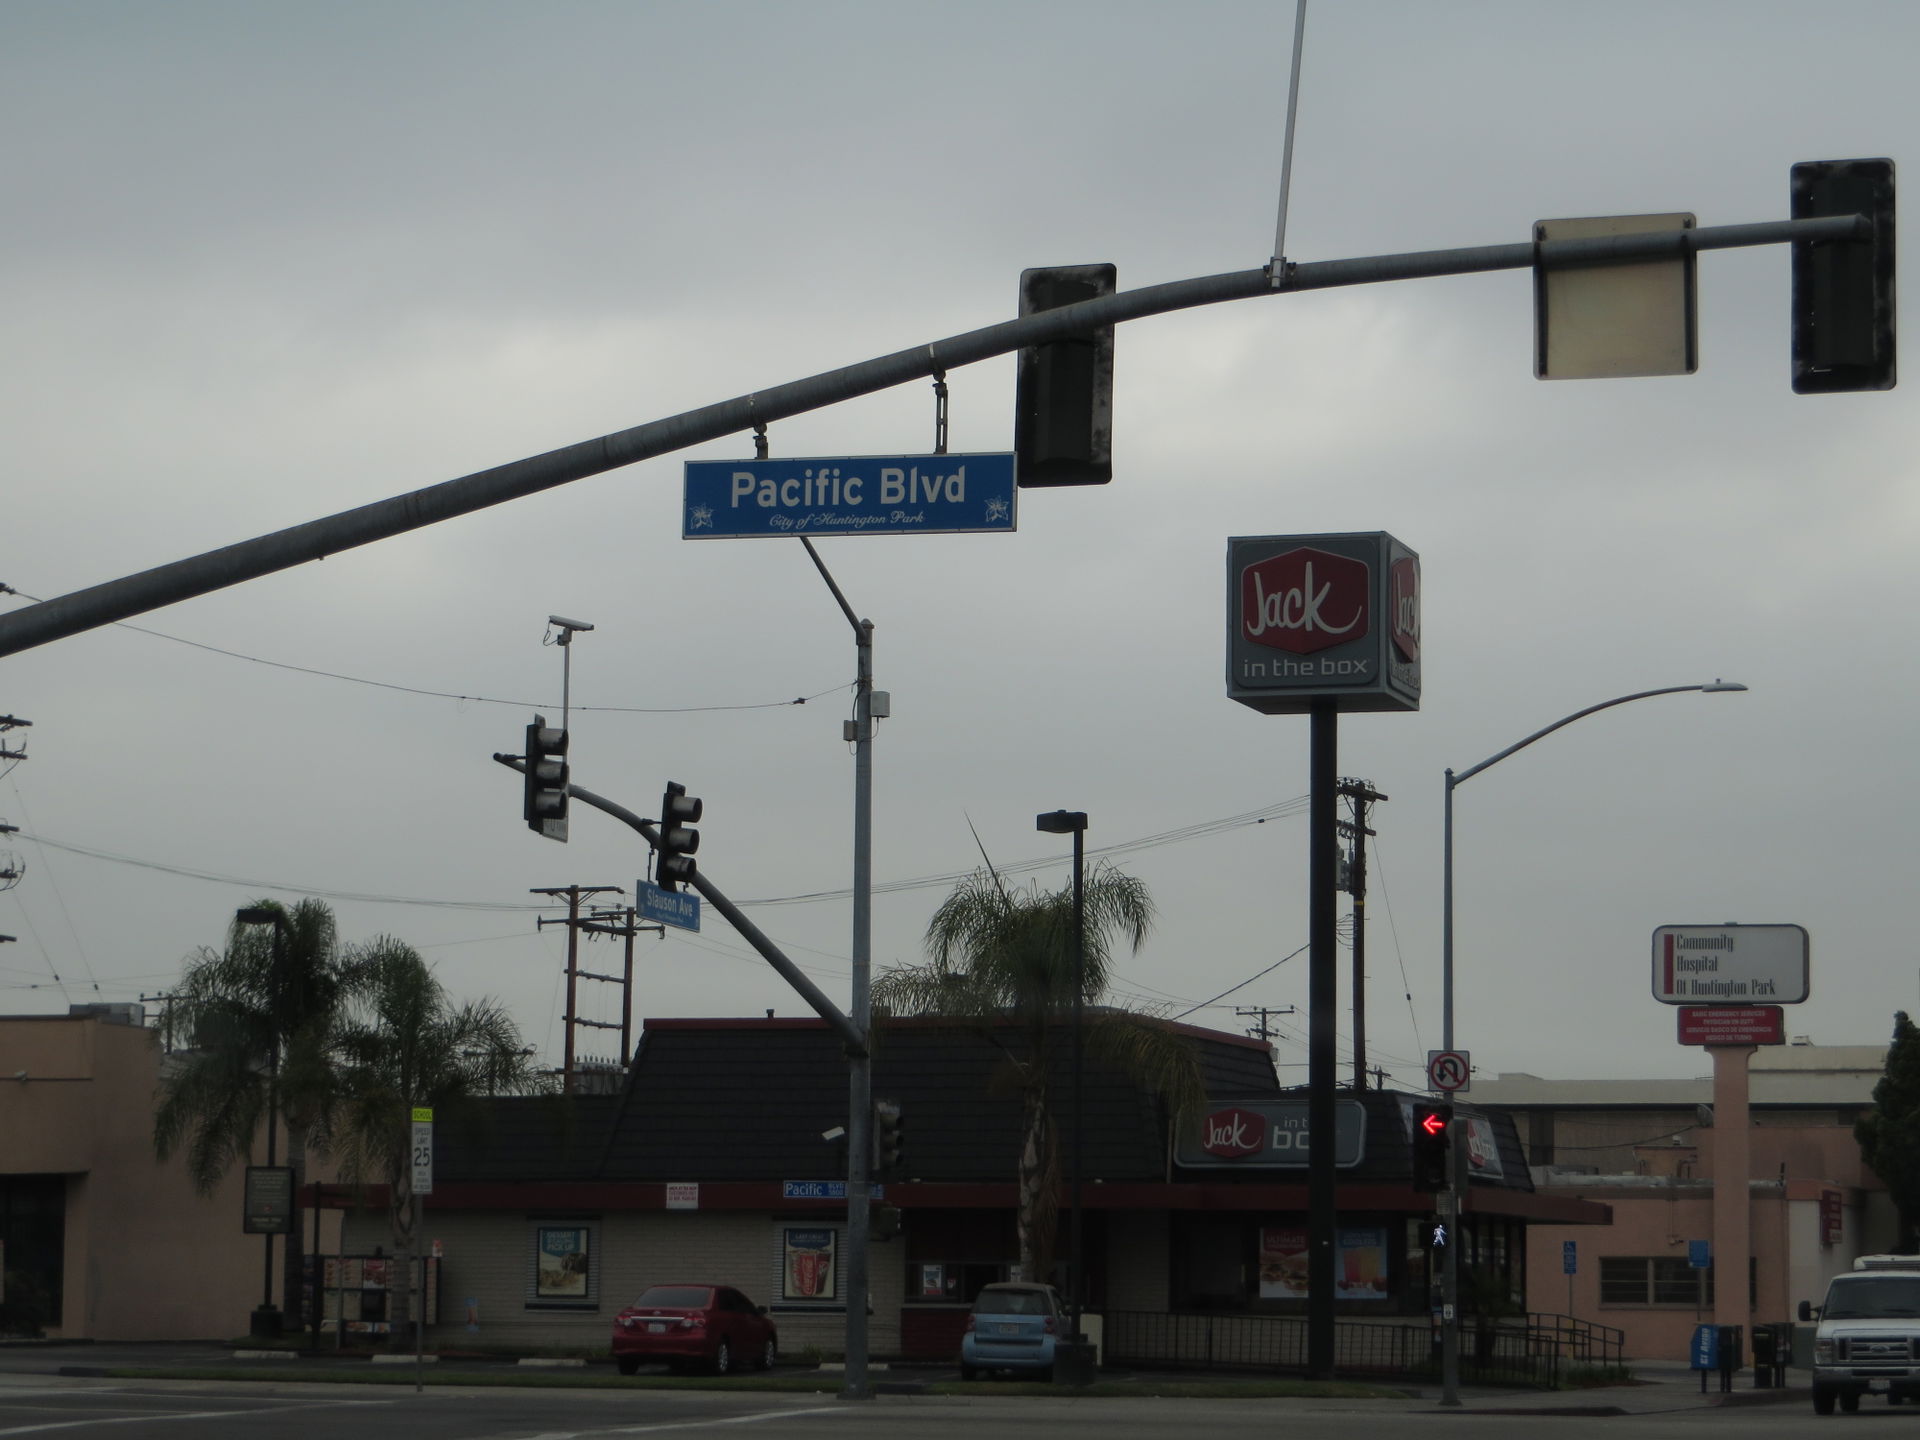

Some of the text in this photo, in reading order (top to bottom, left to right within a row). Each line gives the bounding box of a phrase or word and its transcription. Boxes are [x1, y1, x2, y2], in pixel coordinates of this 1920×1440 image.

[731, 465, 966, 508] Pacific Blvd
[769, 510, 924, 530] City of Huntington Park
[1246, 561, 1363, 637] Jack
[1243, 657, 1368, 677] in the box
[647, 888, 677, 913] Slauson
[679, 898, 693, 917] Ave
[1676, 934, 1734, 952] Community
[1677, 956, 1718, 974] Hospital
[1691, 979, 1747, 997] Huntington
[1751, 979, 1776, 995] Park
[1203, 1113, 1262, 1149] Jack
[1284, 1116, 1298, 1128] in
[1272, 1125, 1310, 1149] bo
[414, 1147, 430, 1167] 25
[785, 1183, 823, 1196] Pacific
